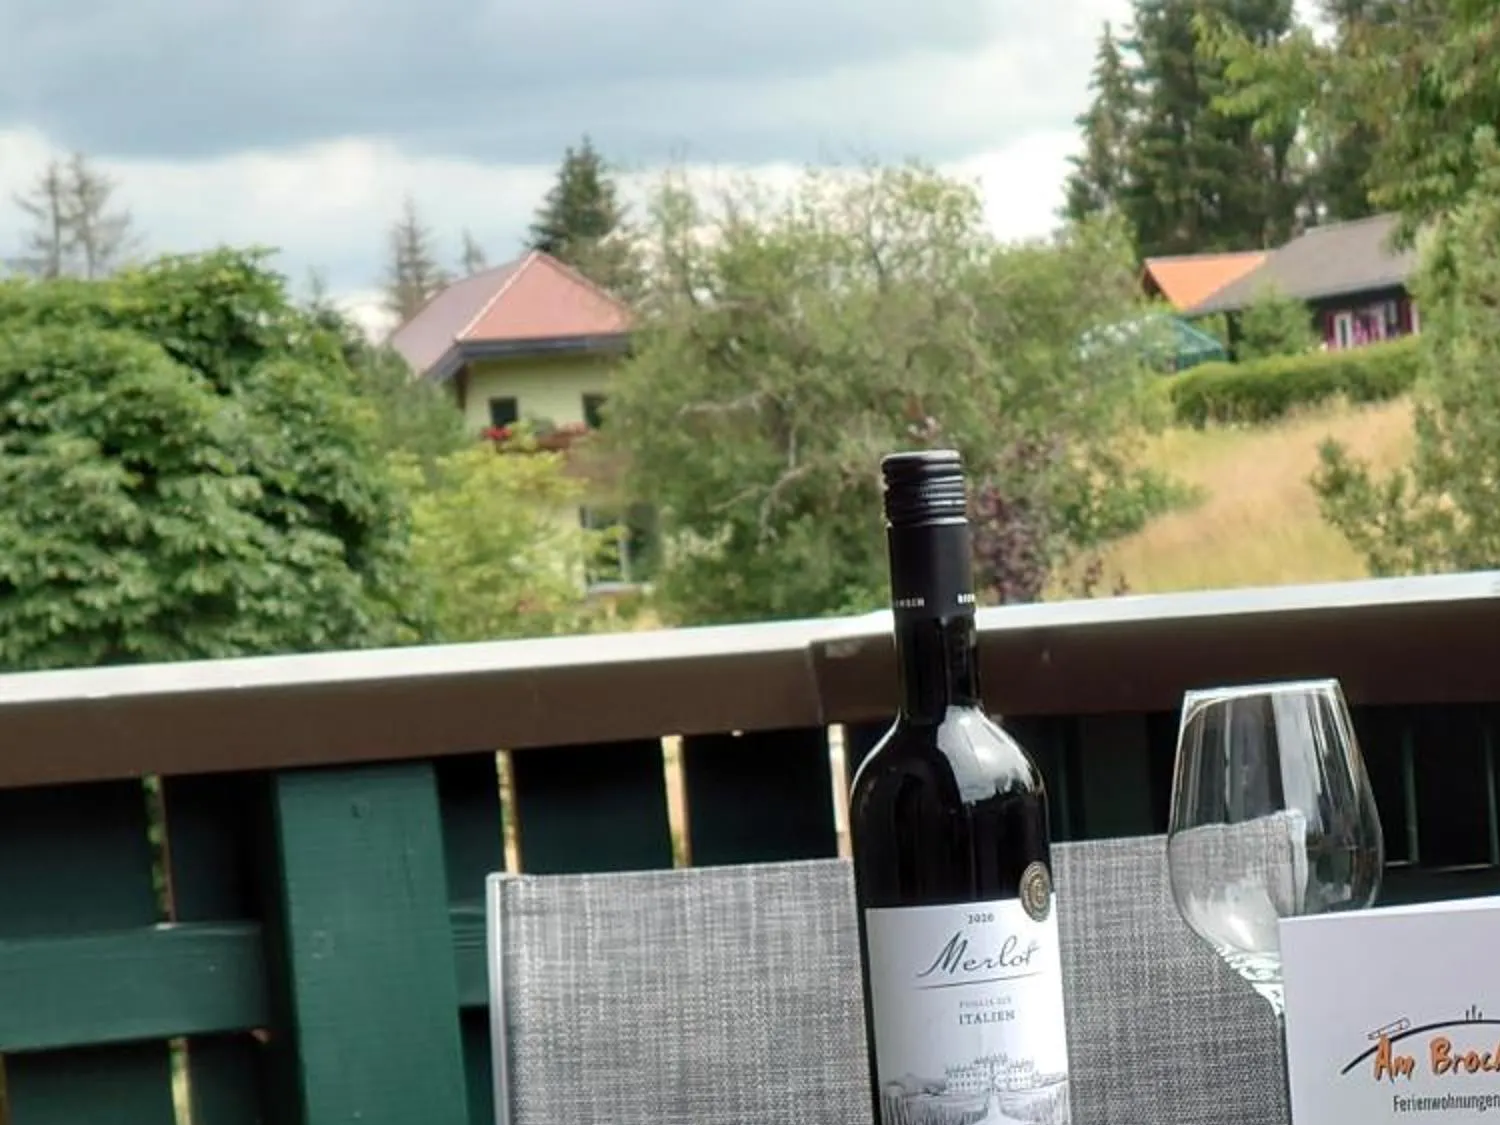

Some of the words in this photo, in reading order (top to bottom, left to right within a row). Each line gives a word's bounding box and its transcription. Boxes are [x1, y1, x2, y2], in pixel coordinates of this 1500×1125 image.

[916, 930, 1040, 978] Merlot
[959, 1010, 1015, 1025] ITALIEN
[1373, 1034, 1415, 1083] Am
[1393, 1093, 1500, 1112] Ferienwohnungen
